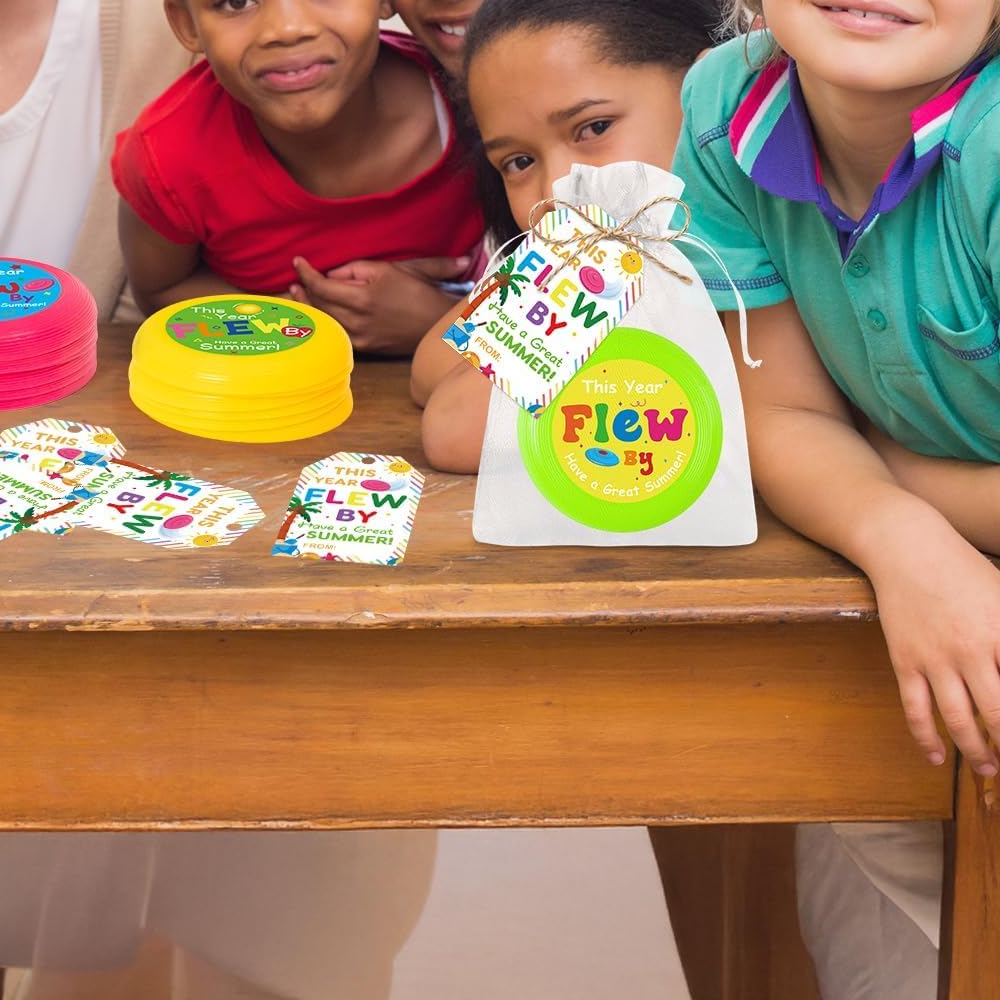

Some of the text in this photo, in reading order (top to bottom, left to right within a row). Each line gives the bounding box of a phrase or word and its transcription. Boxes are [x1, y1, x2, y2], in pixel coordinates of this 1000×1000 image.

[572, 227, 607, 265] THIS
[10, 293, 34, 303] By
[516, 250, 609, 329] FLEW
[190, 306, 226, 314] This
[215, 312, 257, 320] Year
[526, 300, 567, 337] BY
[168, 318, 290, 339] FLEW
[285, 327, 312, 338] By
[488, 301, 563, 368] Have a Great
[200, 342, 280, 351] Summer!
[474, 336, 502, 363] FROM:
[485, 320, 557, 383] SUMMER!
[582, 379, 664, 394] This Year
[561, 402, 689, 443] Flew
[10, 440, 56, 453] YEAR
[35, 432, 78, 446] THIS
[334, 466, 377, 477] THIS
[623, 450, 654, 476] By
[108, 471, 135, 489] Have
[314, 476, 358, 487] YEAR
[565, 450, 687, 497] Have a Great Summer!
[72, 497, 103, 515] Great
[107, 491, 145, 514] BY
[186, 493, 223, 515] YEAR
[304, 488, 408, 509] FLEW
[122, 482, 202, 534] FLEW
[198, 505, 235, 528] THIS
[336, 509, 378, 523] BY
[297, 521, 334, 531] Have
[353, 525, 394, 535] Great
[302, 542, 337, 551] FROM:
[306, 531, 394, 545] SUMMER!
